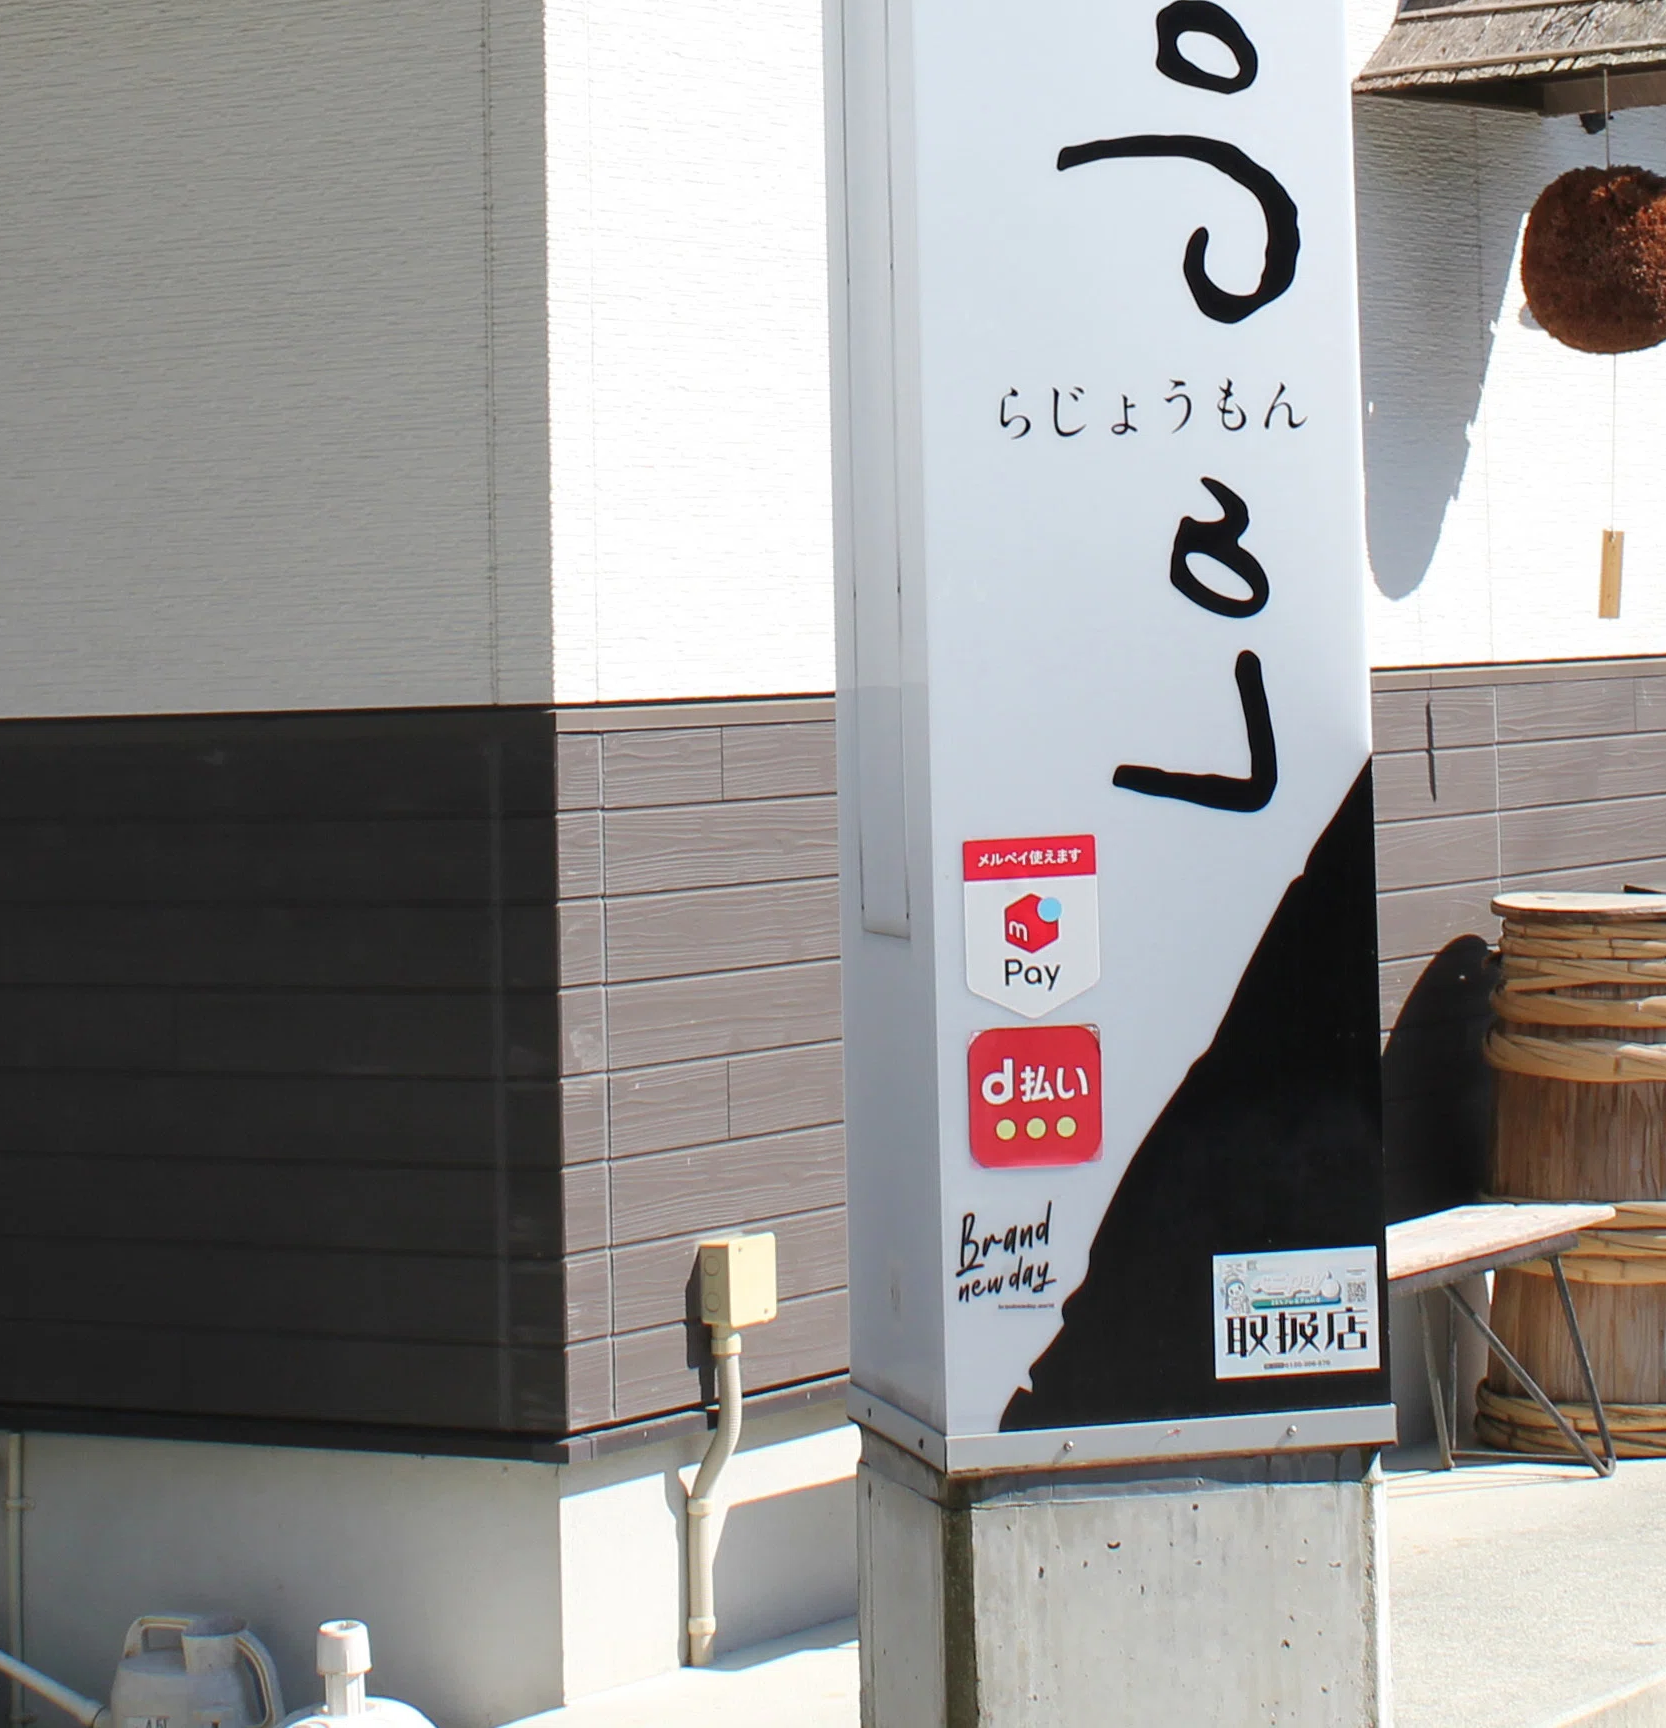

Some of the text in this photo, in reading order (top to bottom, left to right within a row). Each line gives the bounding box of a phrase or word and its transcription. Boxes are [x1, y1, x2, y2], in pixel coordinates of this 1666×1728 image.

[999, 377, 1309, 440] らじょうもん
[1112, 476, 1278, 813] La
[977, 847, 1082, 868] メルペイ使えます
[1004, 958, 1061, 991] Pay
[981, 1058, 1089, 1106] d払い
[955, 1200, 1052, 1278] Brand
[1225, 1306, 1369, 1358] 取扱店
